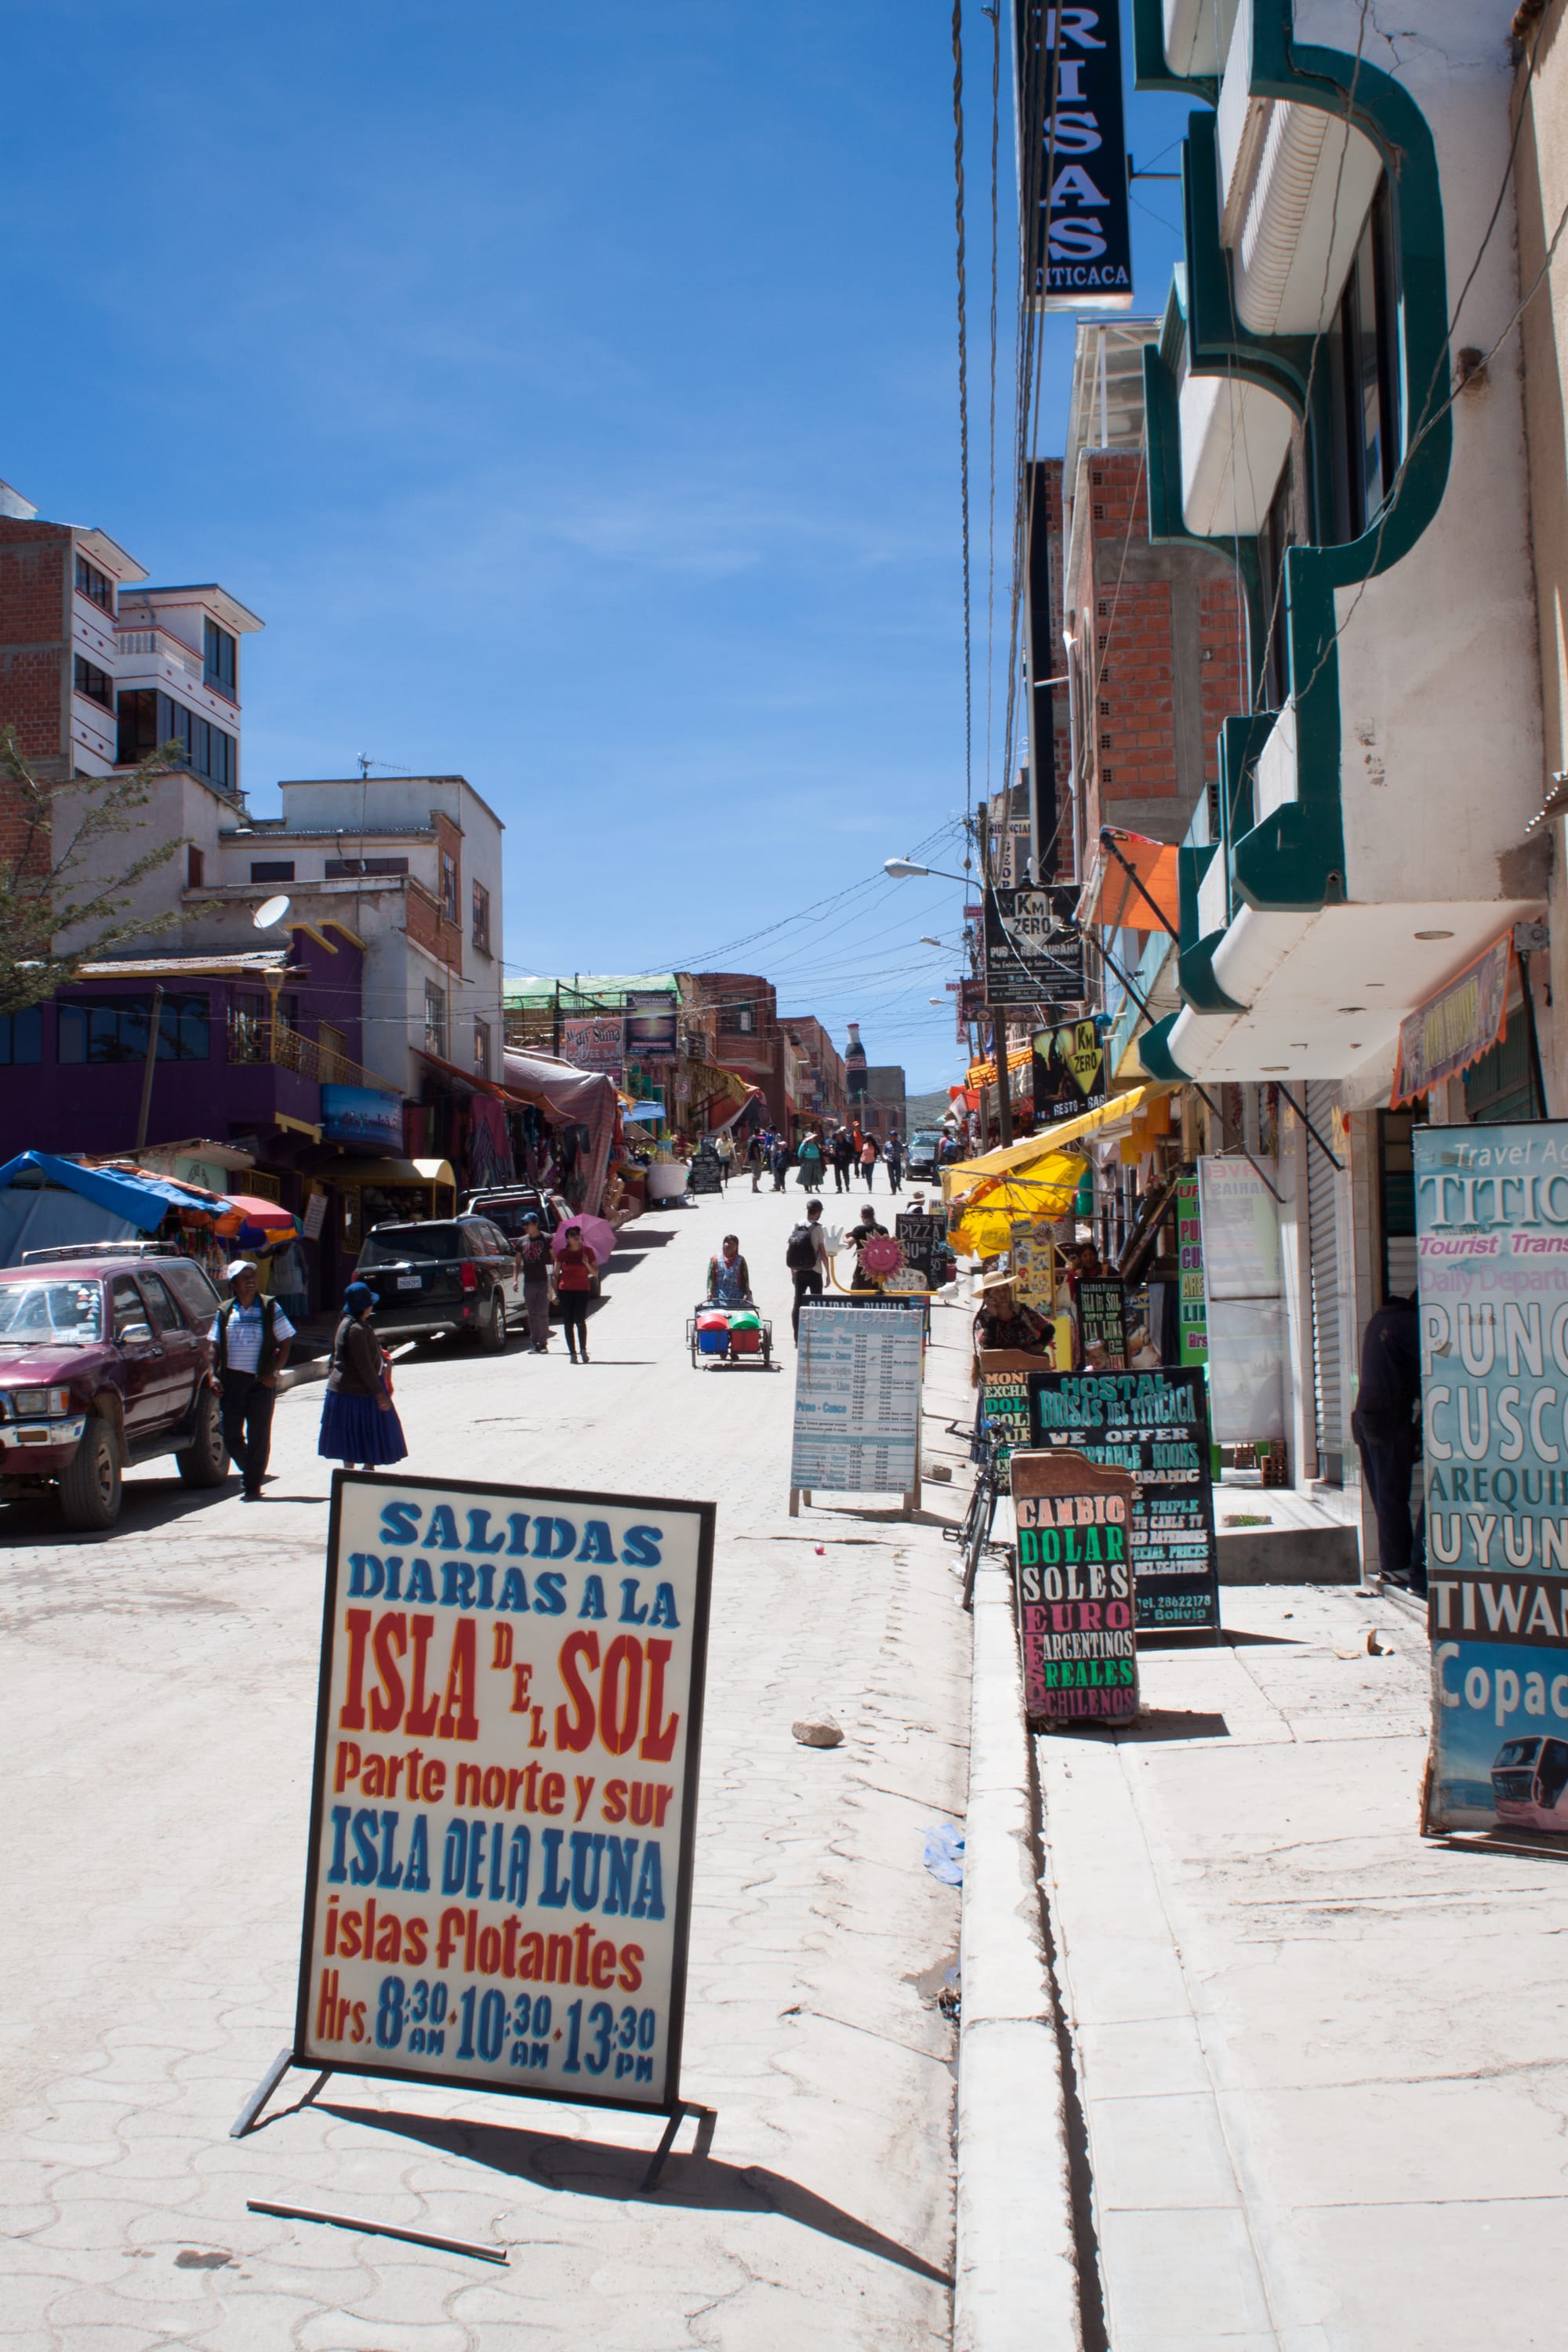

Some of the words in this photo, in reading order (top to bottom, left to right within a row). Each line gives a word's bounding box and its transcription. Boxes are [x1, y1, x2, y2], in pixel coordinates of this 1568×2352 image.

[1035, 265, 1130, 287] TITICACA
[1013, 917, 1051, 935] ZERO
[990, 946, 1009, 957] PUB
[1021, 943, 1079, 956] RESTAURANT
[1074, 1052, 1097, 1073] ZERO
[1054, 1100, 1078, 1116] RESTO
[1455, 1140, 1531, 1168] Travel
[899, 1224, 940, 1239] PIZZA
[1419, 1235, 1499, 1255] Tourist
[1419, 1266, 1475, 1298] Daily
[1106, 1292, 1121, 1312] SOL
[800, 1310, 837, 1322] BUS
[844, 1311, 921, 1324] TICKETS
[1103, 1321, 1123, 1340] LUNA
[985, 1373, 1029, 1385] MON
[1060, 1374, 1172, 1401] HOSTAL
[985, 1398, 1029, 1413] DOL
[1039, 1390, 1103, 1428] BRISAS
[1107, 1401, 1129, 1426] DEL
[1131, 1385, 1197, 1425] TITICACA
[1048, 1432, 1086, 1444] WE
[1105, 1428, 1189, 1443] OFFER
[1425, 1385, 1568, 1463] CUSC
[1152, 1443, 1200, 1468] ROOMS
[1130, 1469, 1200, 1484] ORAMIC
[1427, 1467, 1568, 1513] AREQUI
[1017, 1496, 1125, 1527] CAMBIO
[1151, 1500, 1200, 1514] TRIPLE
[379, 1502, 663, 1568] SALIDAS
[1150, 1515, 1185, 1529] CABLE
[1189, 1515, 1203, 1528] TV
[1019, 1526, 1124, 1565] DOLAR
[1131, 1546, 1166, 1560] PECIAL
[1169, 1544, 1209, 1559] PRICES
[347, 1552, 567, 1617] DIARIAS
[578, 1574, 608, 1620] A
[618, 1579, 681, 1629] LA
[1022, 1565, 1129, 1602] SOLES
[1025, 1602, 1131, 1634] EURO
[1154, 1609, 1206, 1621] Bolivia
[1428, 1581, 1568, 1638] TIWA
[1043, 1631, 1133, 1661] ARGENTINOS
[339, 1608, 480, 1741] ISLA
[555, 1630, 680, 1762] SOL
[1025, 1634, 1046, 1718] PESOS
[1044, 1660, 1134, 1688] REALES
[1046, 1689, 1134, 1717] CHILENOS
[455, 1761, 565, 1816] norte
[574, 1775, 594, 1823] y
[603, 1778, 674, 1828] sur
[328, 1806, 430, 1891] ISLA
[539, 1828, 666, 1920] LUNA
[324, 1894, 429, 1966] islas
[435, 1906, 645, 1993] flotantes
[408, 2027, 445, 2056] AM
[510, 2041, 549, 2069] AM
[615, 2056, 653, 2083] PM
